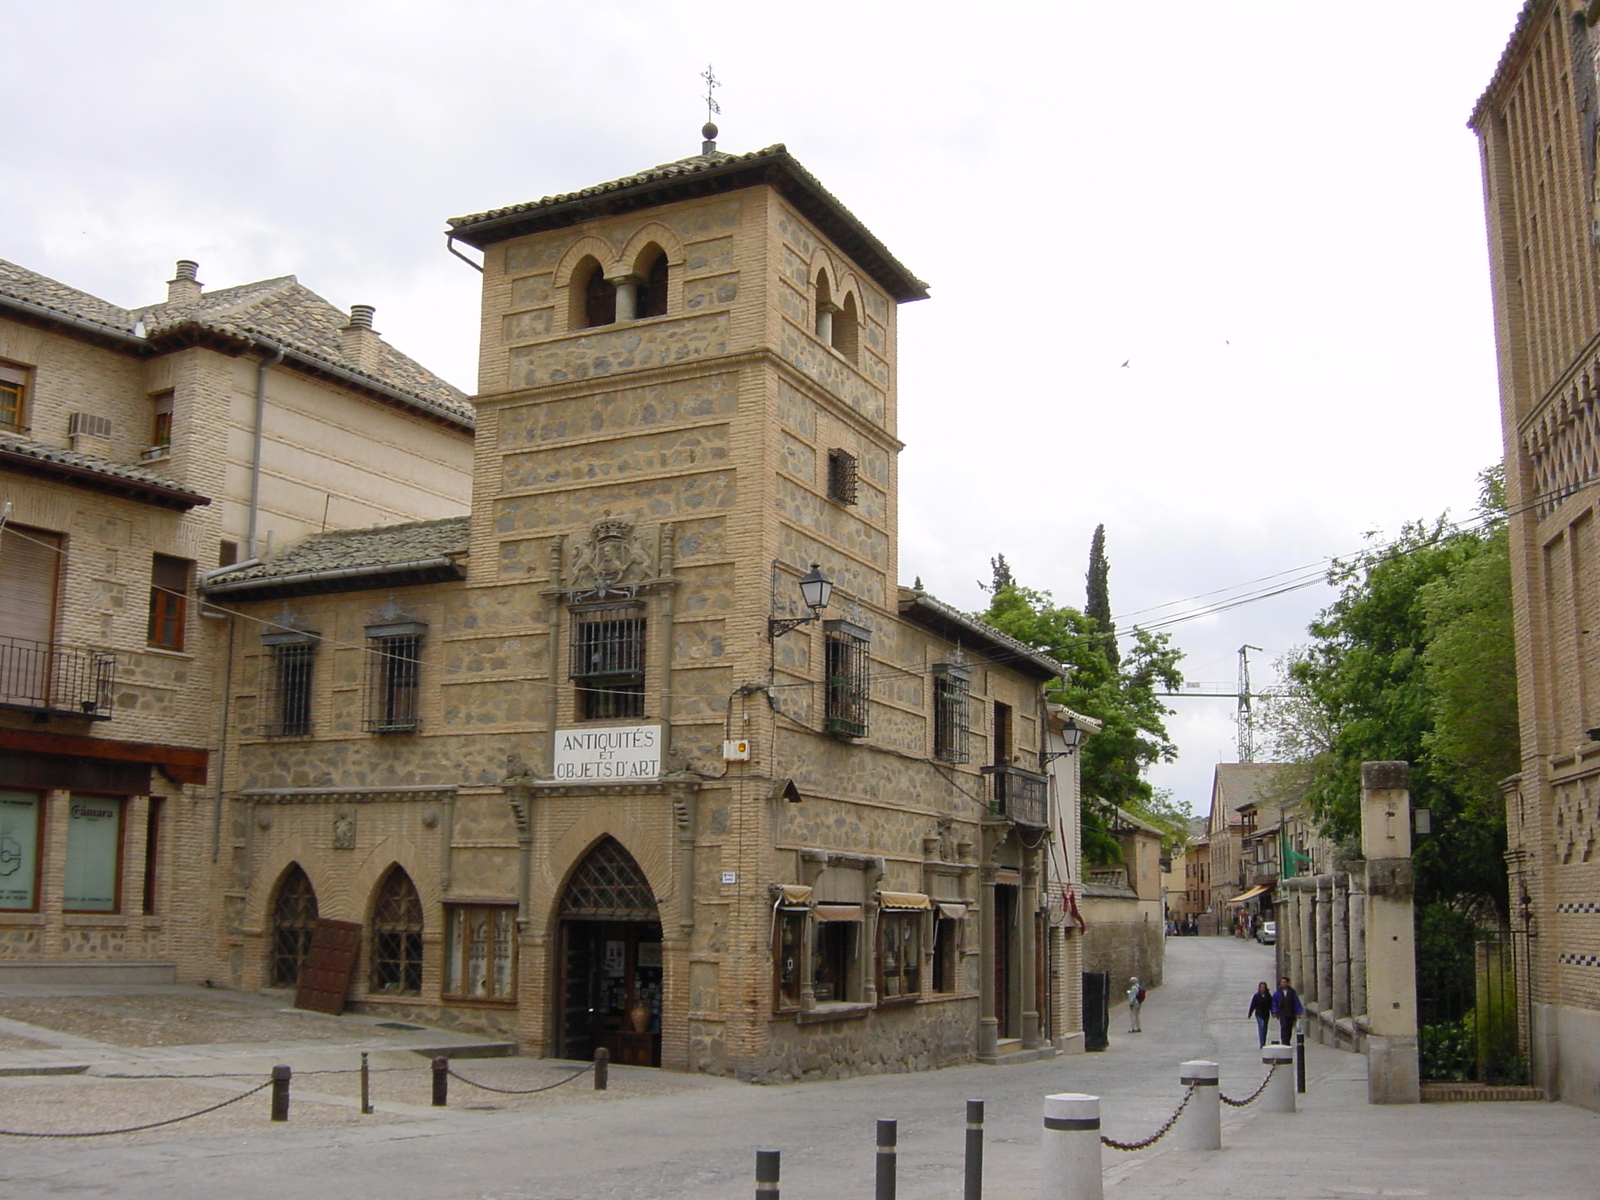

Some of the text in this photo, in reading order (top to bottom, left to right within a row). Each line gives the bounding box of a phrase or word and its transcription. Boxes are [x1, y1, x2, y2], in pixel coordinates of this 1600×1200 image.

[562, 728, 655, 753] ANTIQUITÉS
[599, 751, 615, 760] ET
[556, 760, 659, 778] OBJETS D'ART
[71, 804, 114, 819] Cámara
